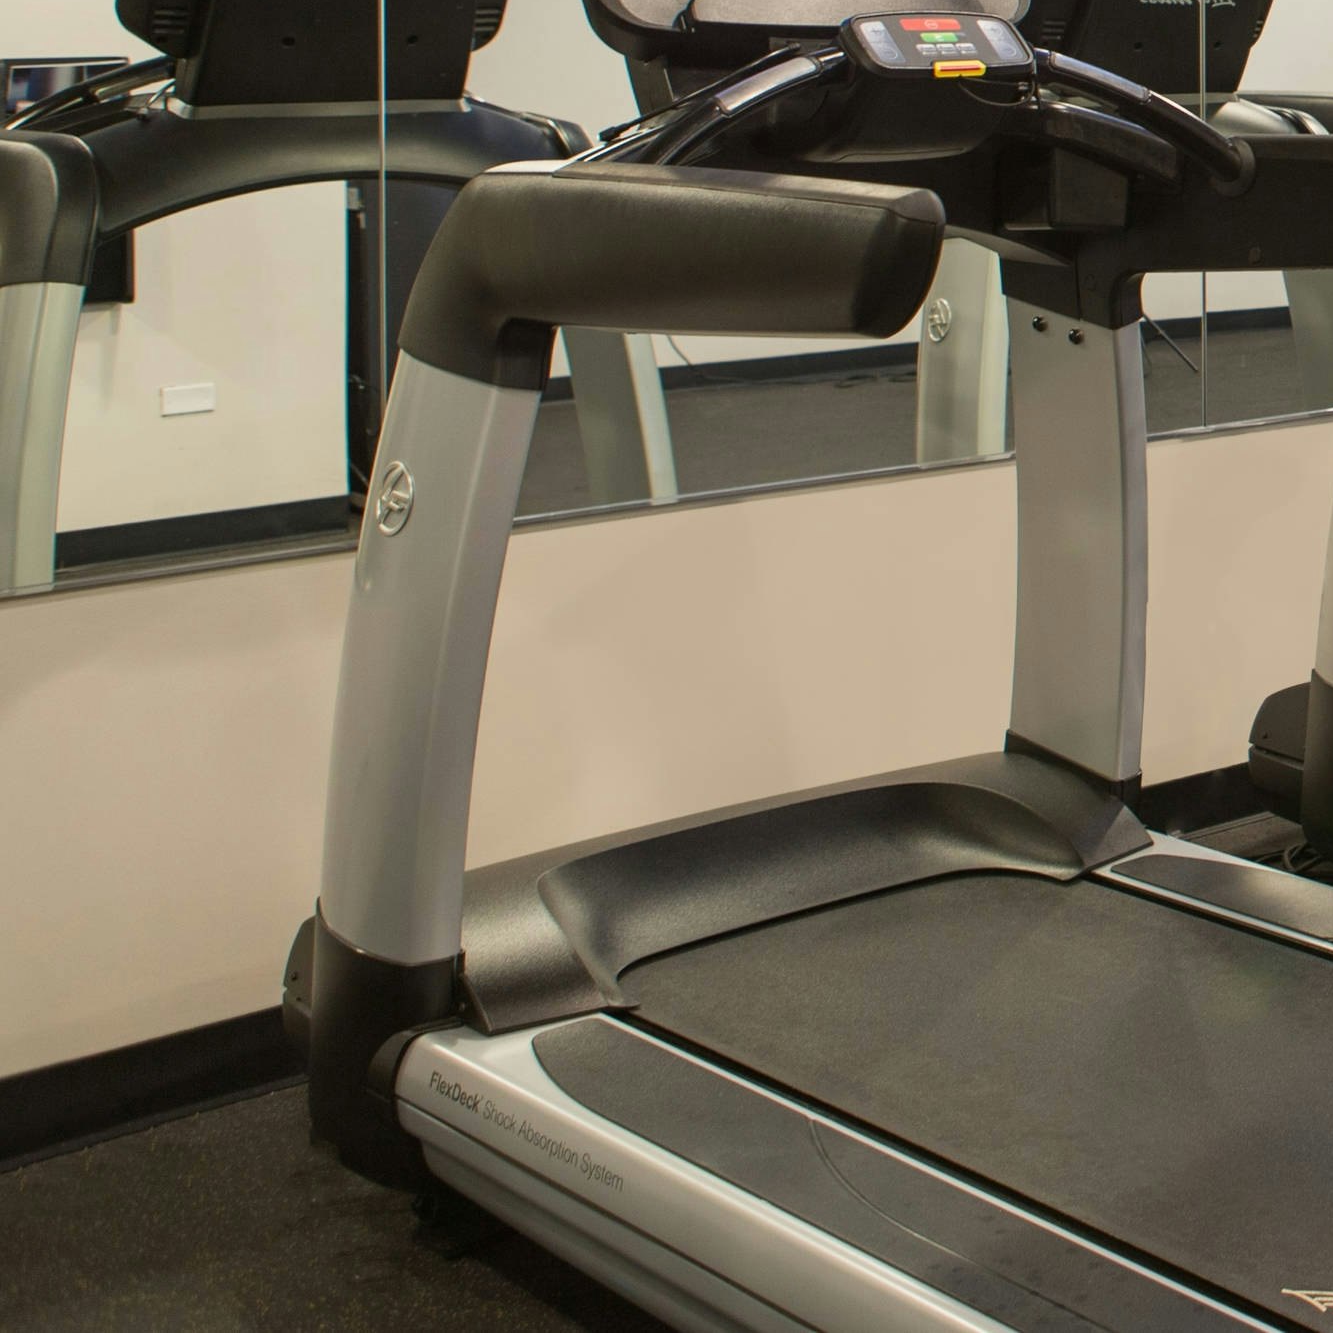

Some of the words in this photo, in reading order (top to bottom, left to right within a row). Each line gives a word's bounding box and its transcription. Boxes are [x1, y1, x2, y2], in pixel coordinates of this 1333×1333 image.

[429, 1071, 481, 1114] FlexDeck
[482, 1100, 517, 1133] Shock
[517, 1119, 579, 1168] Absorption
[580, 1152, 625, 1192] System
